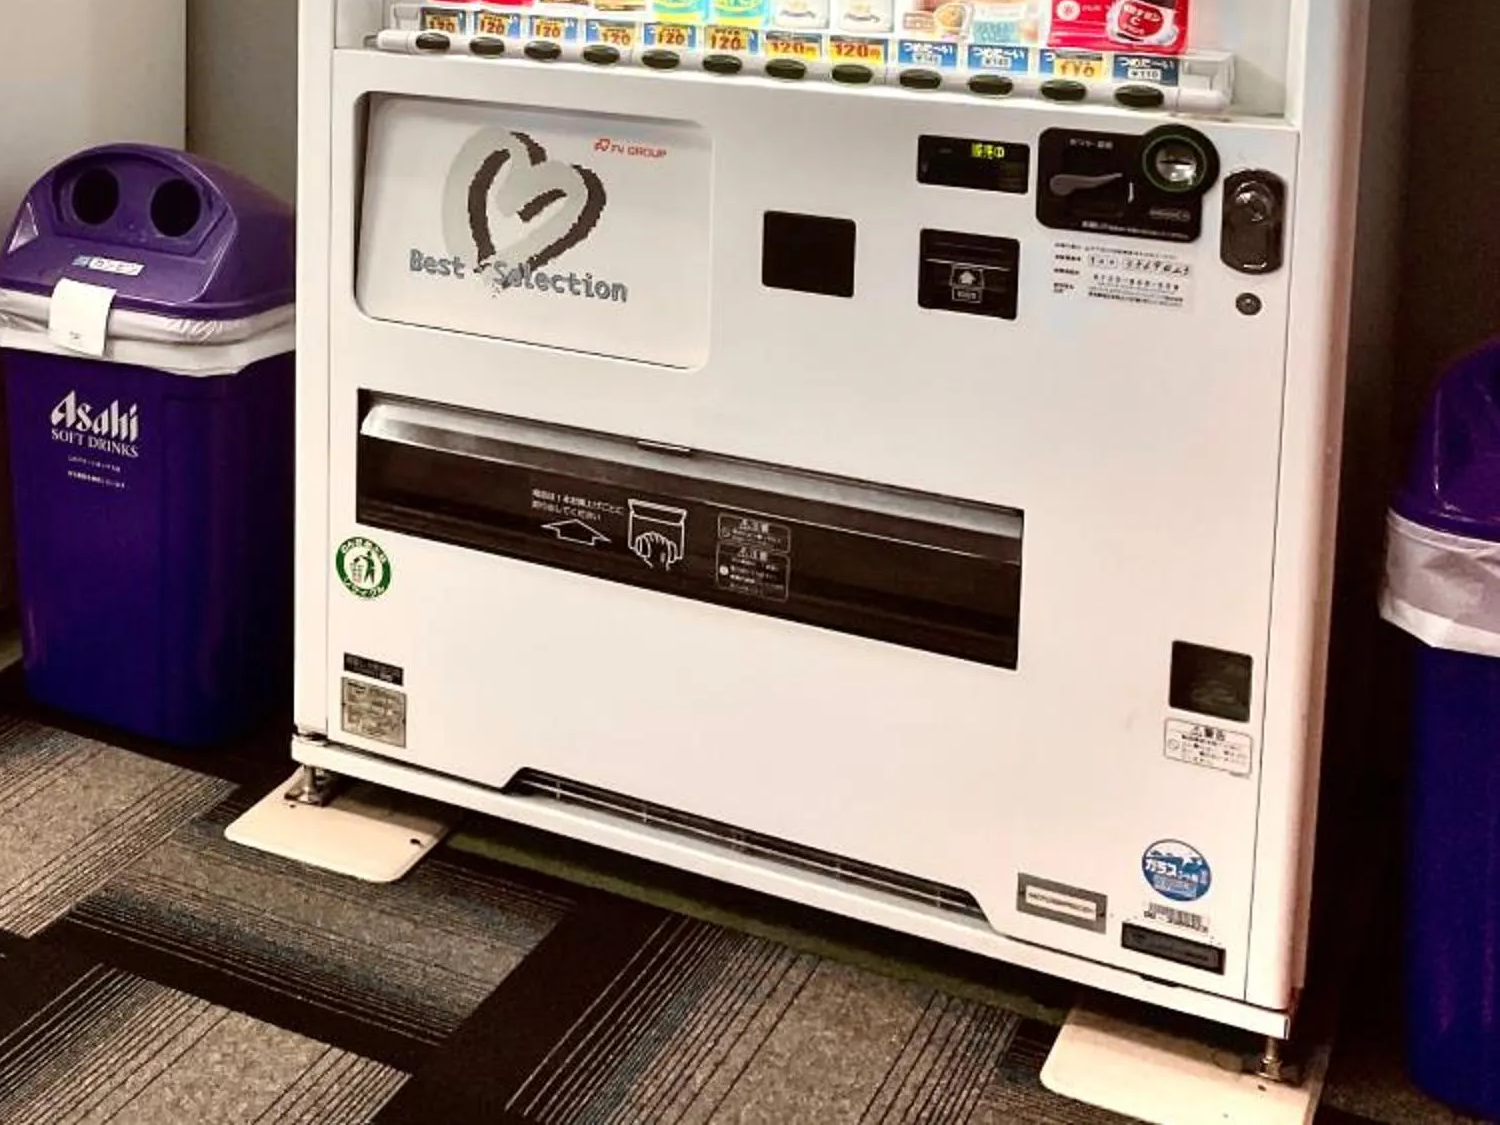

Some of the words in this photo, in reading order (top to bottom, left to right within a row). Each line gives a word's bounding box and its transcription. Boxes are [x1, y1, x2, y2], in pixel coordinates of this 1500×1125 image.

[480, 19, 505, 35] 120
[536, 22, 561, 37] 120
[602, 31, 631, 45] 120
[658, 32, 685, 46] 120
[711, 35, 741, 50] 120
[409, 248, 466, 279] Best
[492, 260, 628, 302] Selection
[51, 389, 139, 443] Asahi
[51, 428, 84, 446] SOFT
[88, 436, 139, 458] DRINKS
